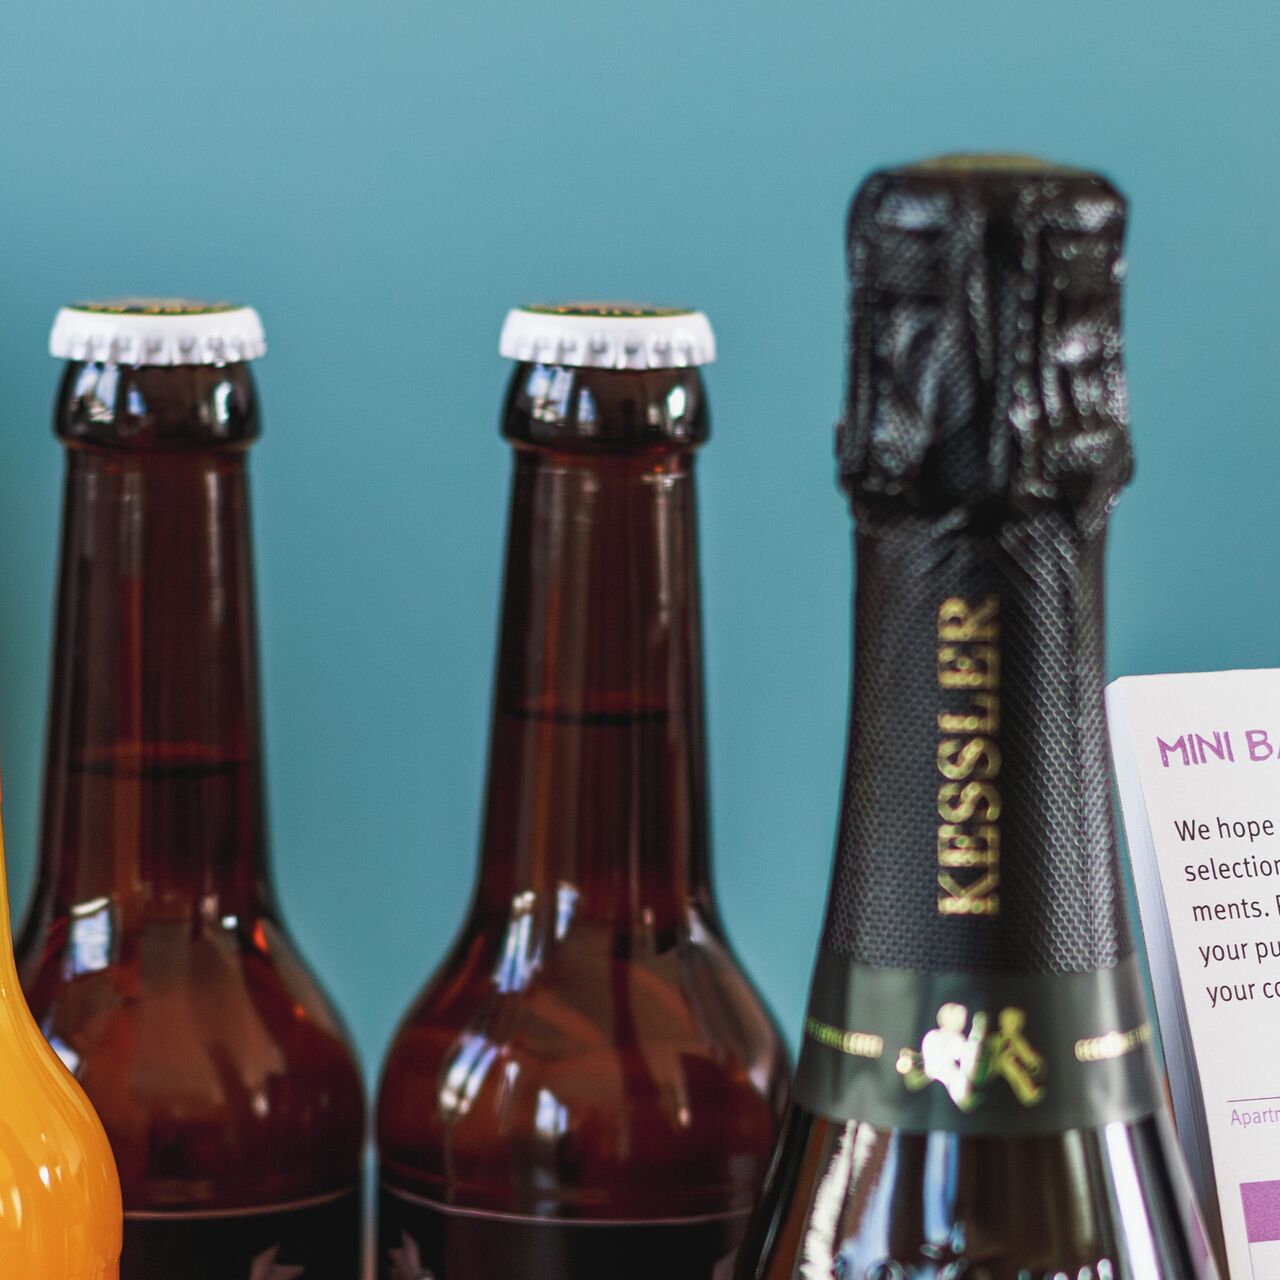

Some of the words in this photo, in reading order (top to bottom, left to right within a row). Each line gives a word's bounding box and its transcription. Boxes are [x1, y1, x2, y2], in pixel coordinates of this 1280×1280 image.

[936, 597, 1002, 916] KESSLER
[1157, 731, 1234, 767] MINI
[1174, 819, 1210, 841] We
[1216, 817, 1274, 842] hope
[1192, 899, 1269, 922] ments.
[1199, 943, 1248, 968] your
[1206, 983, 1255, 1008] your
